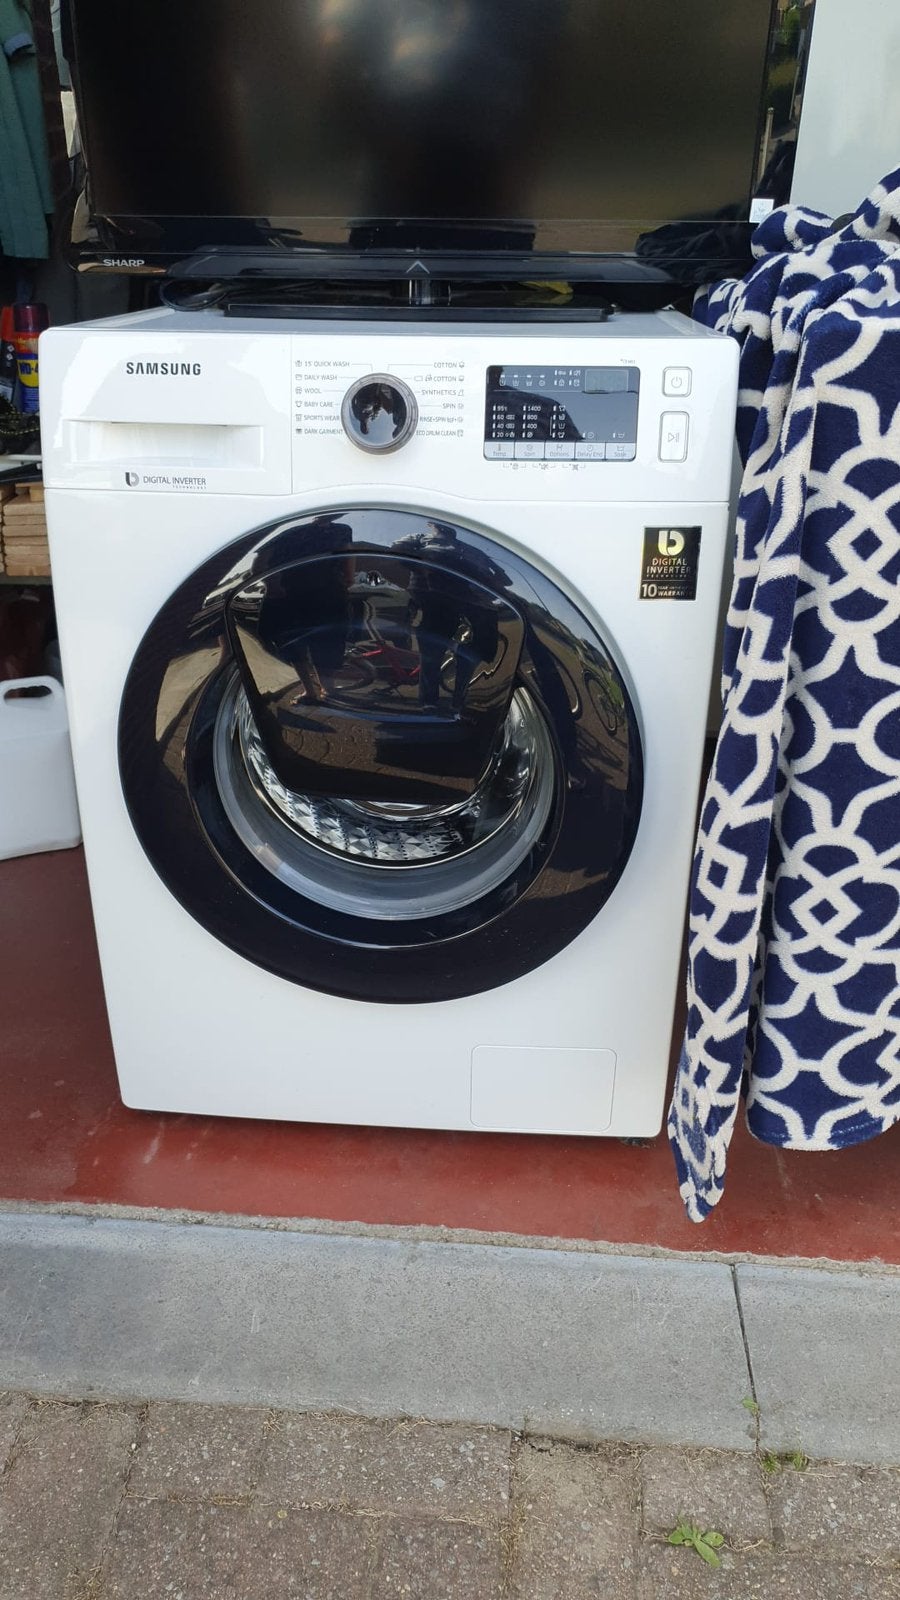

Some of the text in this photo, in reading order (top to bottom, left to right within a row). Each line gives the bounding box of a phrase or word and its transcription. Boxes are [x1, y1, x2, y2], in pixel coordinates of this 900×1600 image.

[103, 259, 145, 267] SHARP
[126, 361, 202, 376] SAMSUNG
[433, 361, 458, 369] COTTON
[304, 387, 322, 395] WOOL
[442, 402, 456, 410] SPIN
[143, 476, 206, 485] DIGITAL INVERTER
[652, 558, 688, 566] DIGITAL
[646, 566, 691, 574] INVERTER
[641, 584, 658, 598] 10
